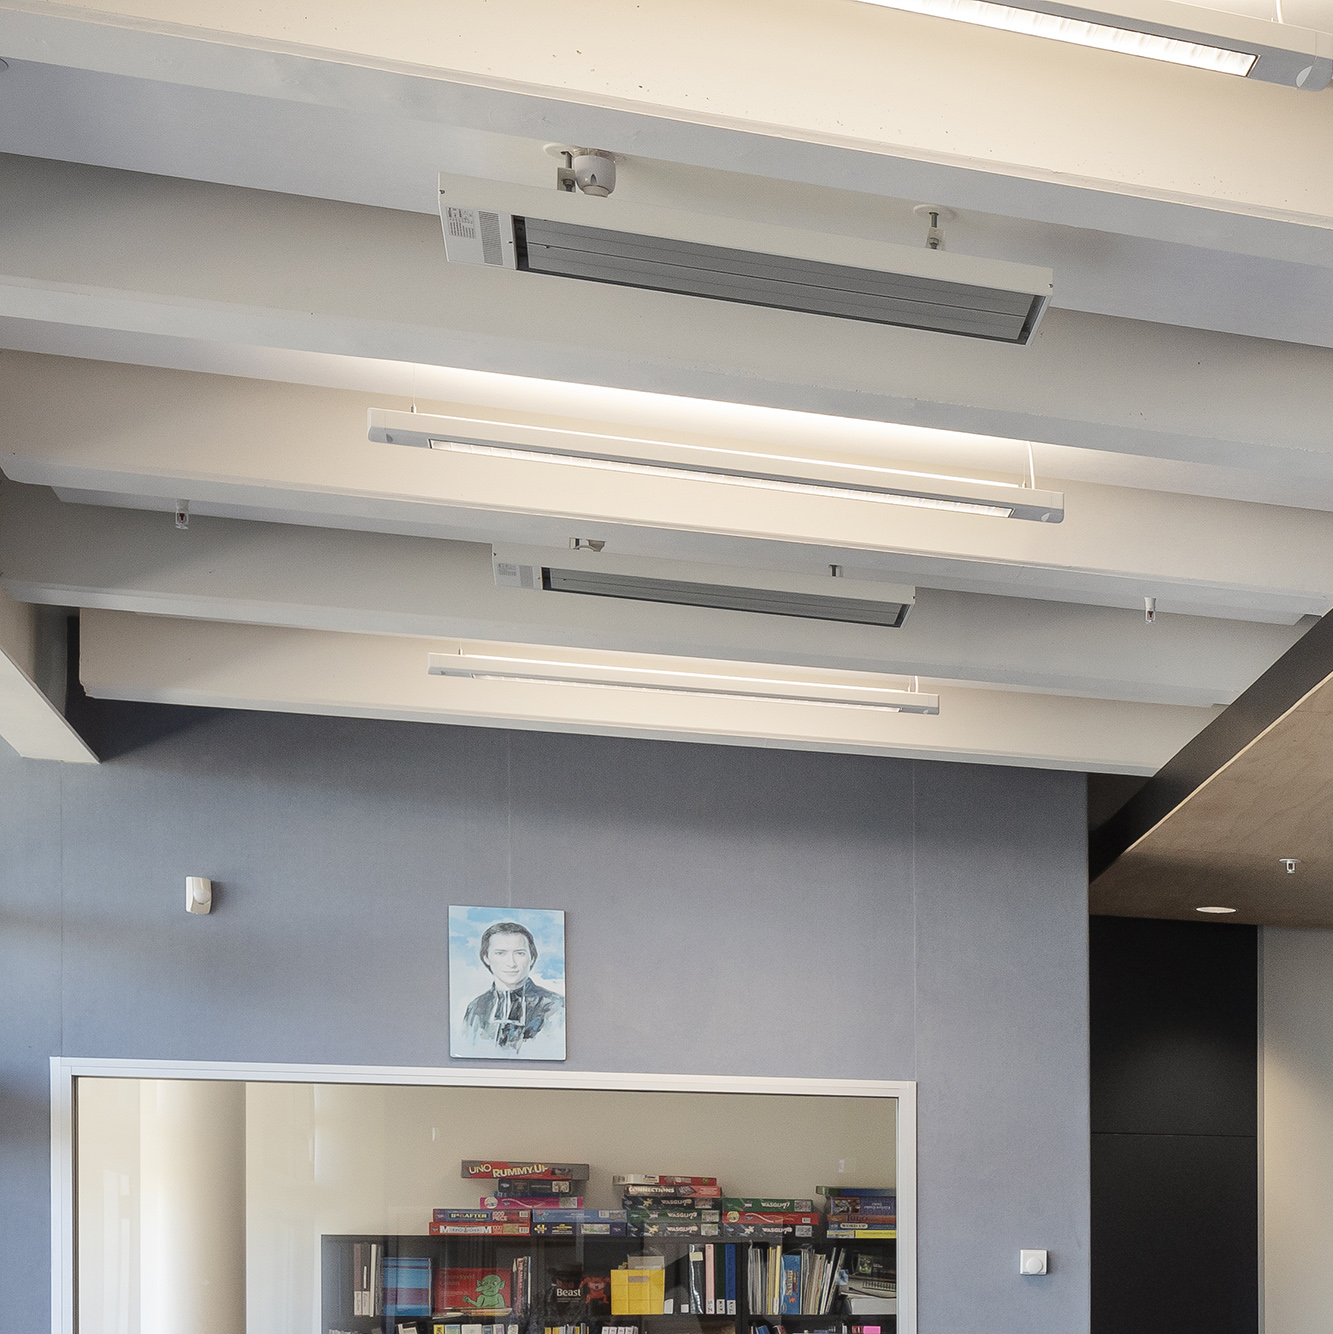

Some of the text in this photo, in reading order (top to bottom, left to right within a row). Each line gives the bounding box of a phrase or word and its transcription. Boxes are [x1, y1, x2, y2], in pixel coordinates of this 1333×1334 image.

[469, 1163, 492, 1174] UNO
[628, 1186, 675, 1194] CONNECTIONS
[556, 1288, 581, 1297] Beast
